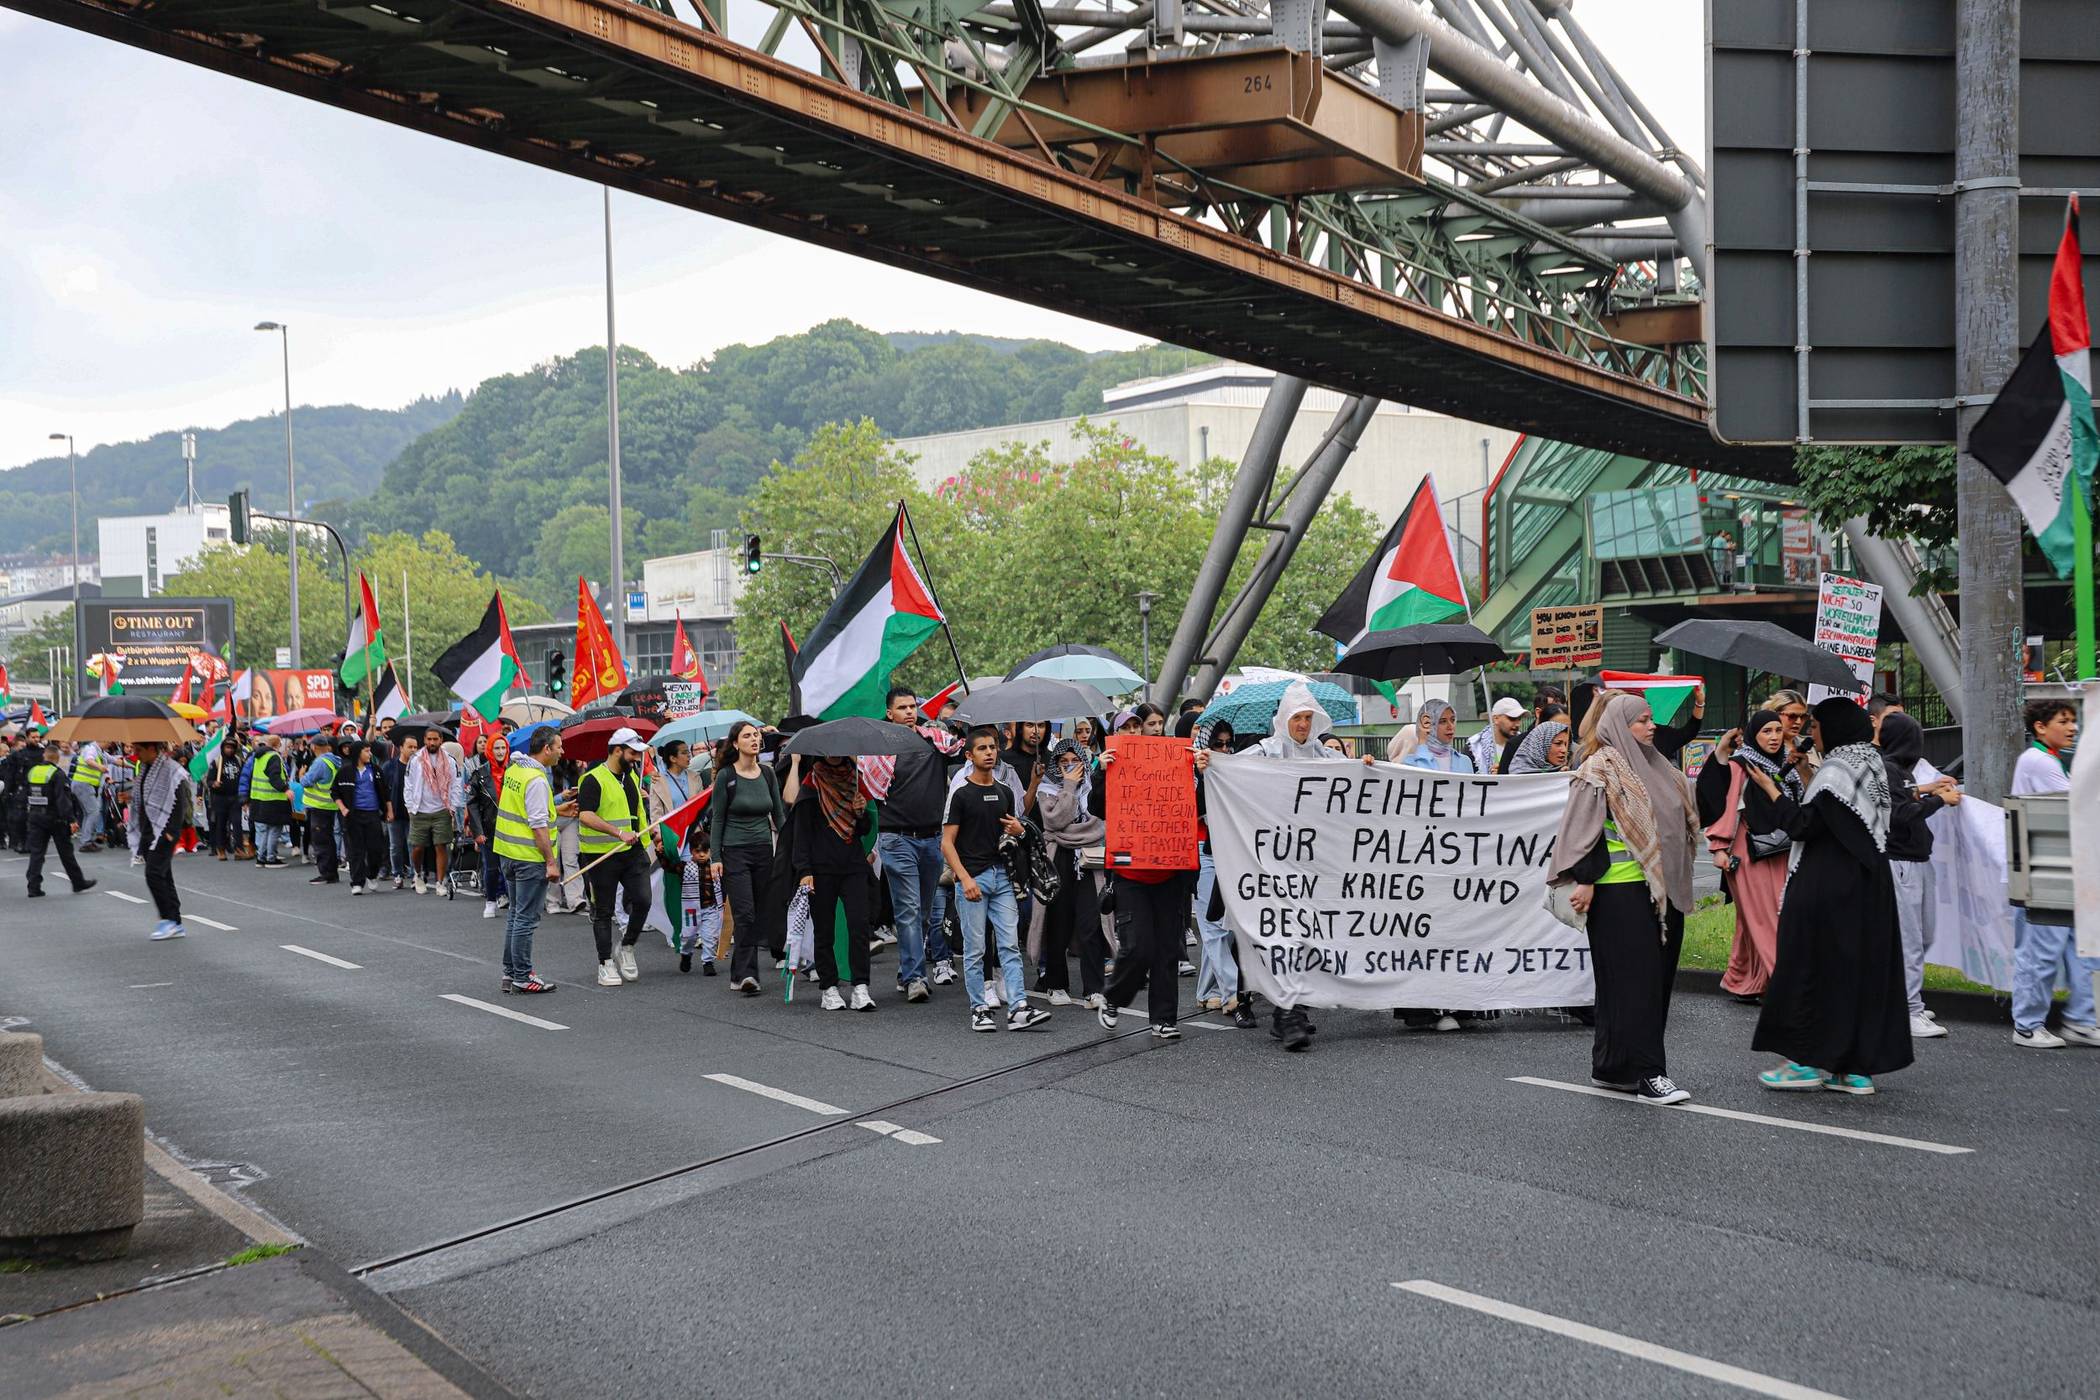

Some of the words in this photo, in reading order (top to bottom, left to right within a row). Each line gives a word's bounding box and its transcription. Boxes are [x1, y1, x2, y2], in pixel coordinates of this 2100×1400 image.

[1244, 74, 1272, 93] 264
[1821, 592, 1848, 608] NICHT
[1851, 599, 1863, 611] SO
[127, 616, 163, 629] TIME
[165, 616, 195, 629] OUT
[1536, 613, 1552, 624] YOU
[1555, 611, 1577, 621] KNOW
[130, 630, 186, 638] RESTAURANT
[116, 645, 174, 656] Gutbürgerliche
[175, 645, 200, 654] Küche
[1536, 647, 1550, 655] THE
[127, 657, 133, 665] 2
[140, 657, 149, 665] in
[149, 656, 190, 667] Wuppertal
[306, 674, 330, 690] SPD
[307, 689, 331, 699] WÄHLEN
[1122, 743, 1139, 760] IT
[1145, 743, 1159, 760] IS
[1165, 744, 1192, 761] NOT
[1118, 767, 1127, 780] A
[1121, 785, 1136, 799] IF
[1143, 786, 1152, 801] 1
[1156, 786, 1185, 802] SIDE
[1294, 776, 1499, 818] FREIHEIT
[1120, 803, 1143, 817] HAS
[1147, 803, 1168, 817] THE
[1170, 804, 1195, 819] GUN
[1117, 820, 1126, 833] &
[1130, 820, 1149, 833] THE
[1150, 821, 1190, 834] OTHER
[1118, 835, 1134, 849] IS
[1142, 835, 1195, 853] PRAYING
[1254, 825, 1317, 866] FÜR
[1237, 872, 1319, 901] GEGEN
[1341, 872, 1425, 901] KRIEG
[1453, 877, 1520, 906] UND
[1259, 907, 1432, 940] BESATZUNG
[1364, 948, 1494, 975] SCHAFFEN
[1505, 948, 1591, 975] JETZT
